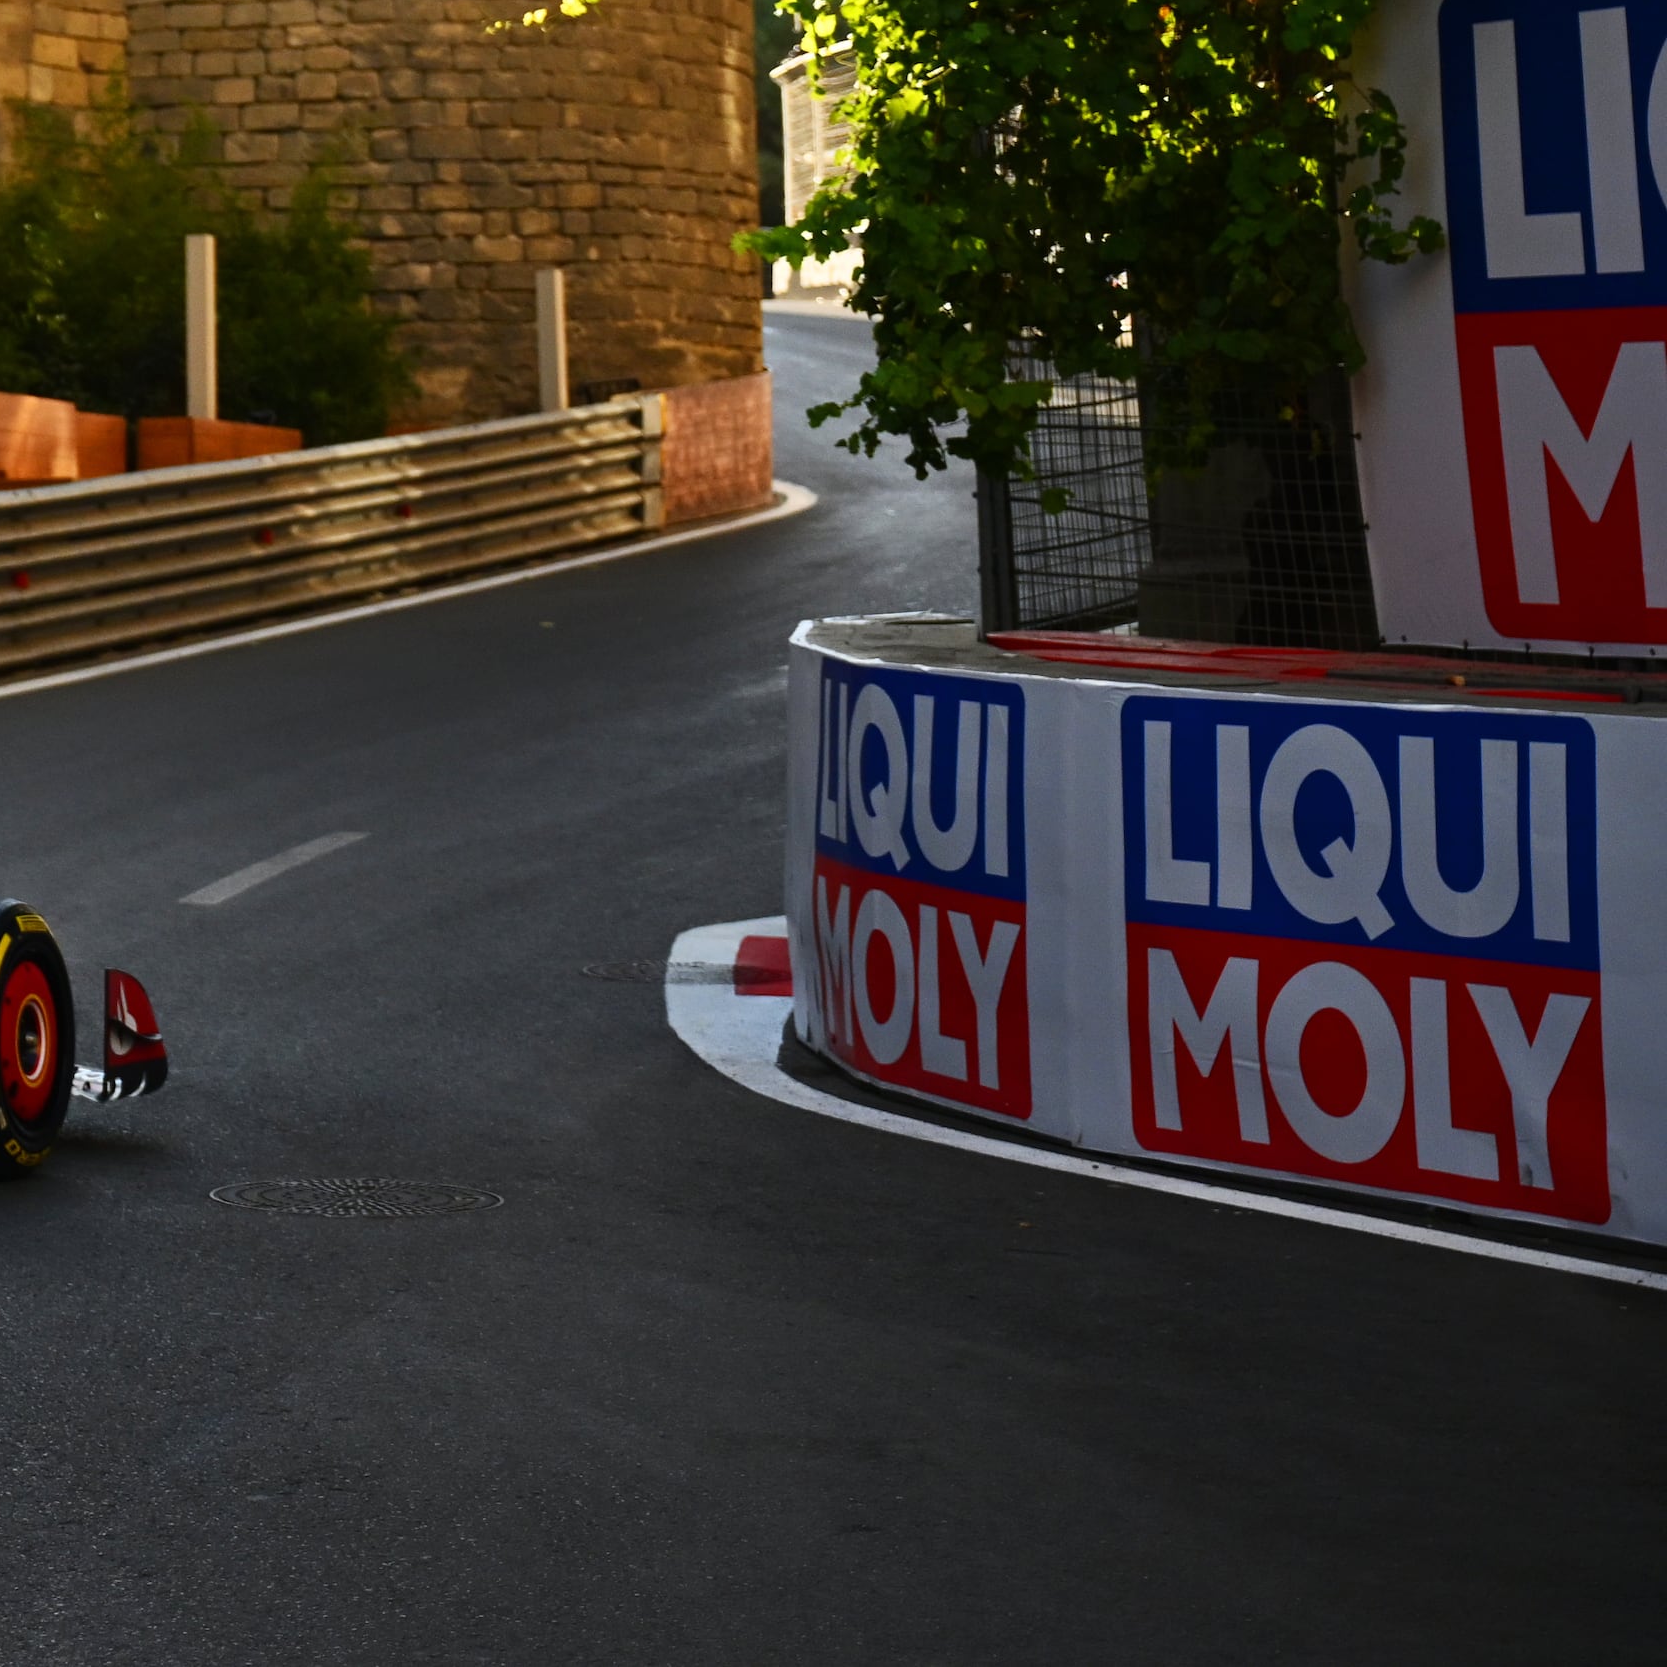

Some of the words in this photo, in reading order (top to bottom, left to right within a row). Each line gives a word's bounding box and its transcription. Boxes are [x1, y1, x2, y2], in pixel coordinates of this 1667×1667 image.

[1473, 6, 1667, 280] LI
[820, 678, 1010, 877] LIQUI
[1144, 720, 1571, 940] LIQUI
[816, 875, 1021, 1091] MOLY
[1147, 947, 1591, 1191] MOLY
